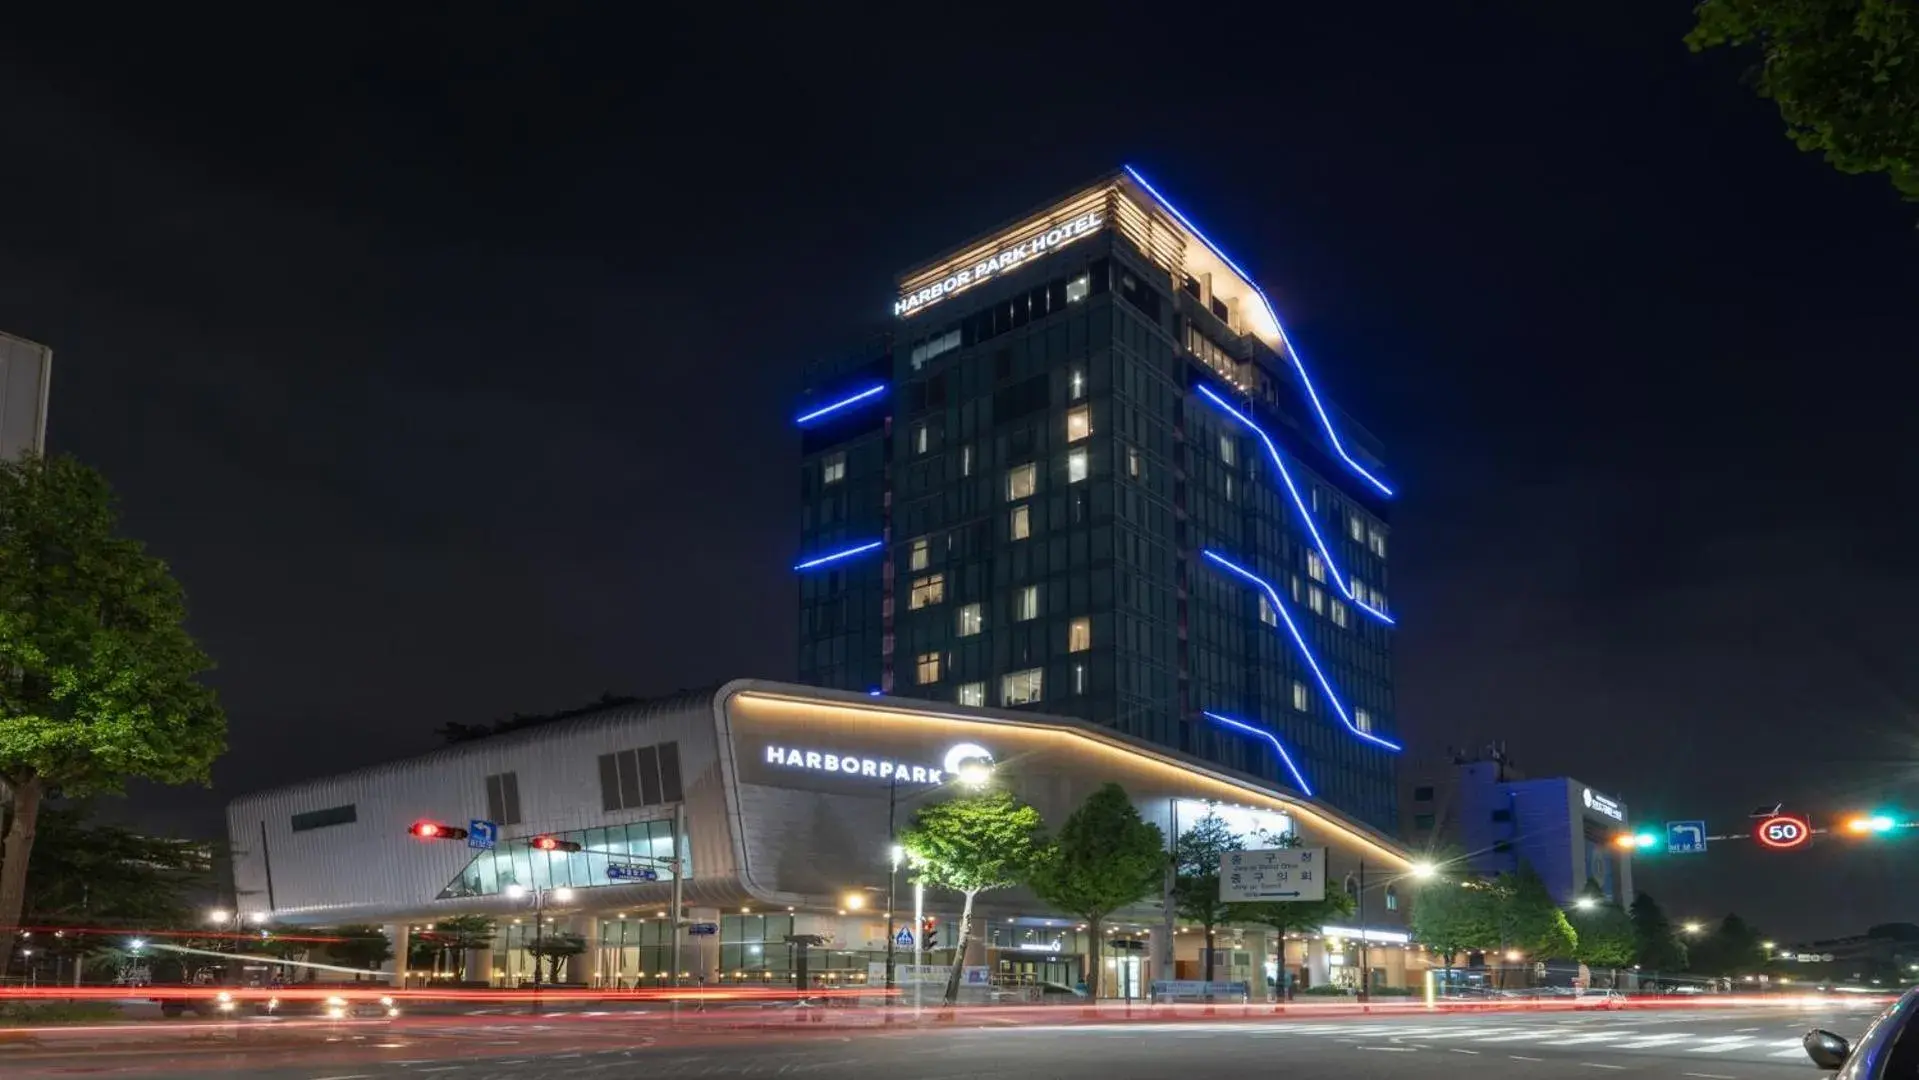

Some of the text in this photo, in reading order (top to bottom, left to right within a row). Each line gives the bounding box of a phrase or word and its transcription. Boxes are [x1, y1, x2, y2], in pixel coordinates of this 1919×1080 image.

[894, 212, 1103, 316] HARBOR PARK HOTEL
[766, 746, 943, 785] HARBORPARK
[1769, 824, 1797, 840] 50
